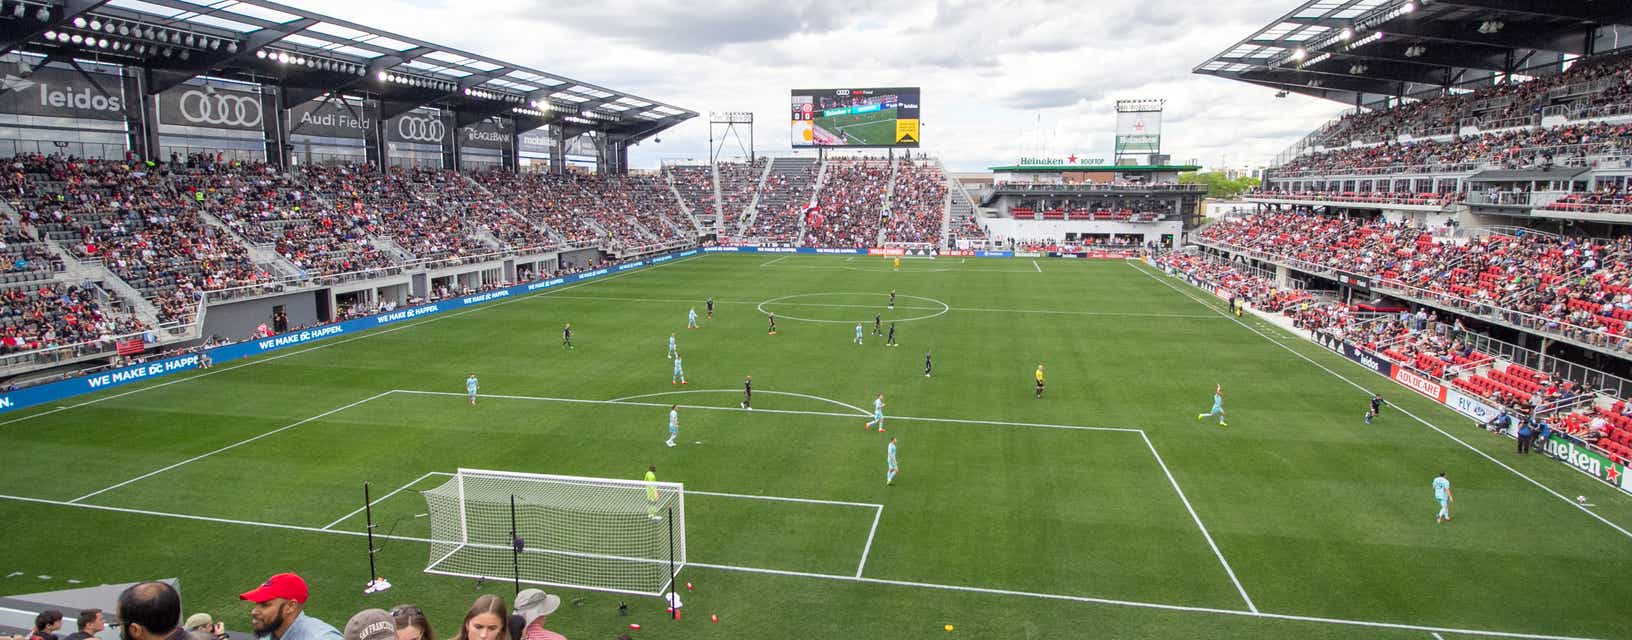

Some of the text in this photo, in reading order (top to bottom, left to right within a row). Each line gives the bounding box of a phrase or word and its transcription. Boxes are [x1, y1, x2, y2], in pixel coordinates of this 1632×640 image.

[41, 83, 121, 112] leidos
[301, 112, 370, 129] Audi Field
[1020, 157, 1064, 165] Heineken
[472, 294, 485, 302] MAKE
[377, 315, 388, 323] WE
[389, 311, 406, 321] MAKE
[259, 325, 343, 350] WE MAKE DC HAPPEN.
[88, 356, 199, 388] WE MAKE DC HAPPE
[1396, 369, 1439, 398] ADVOCARE
[1459, 397, 1471, 410] FLY
[359, 626, 369, 640] SAN
